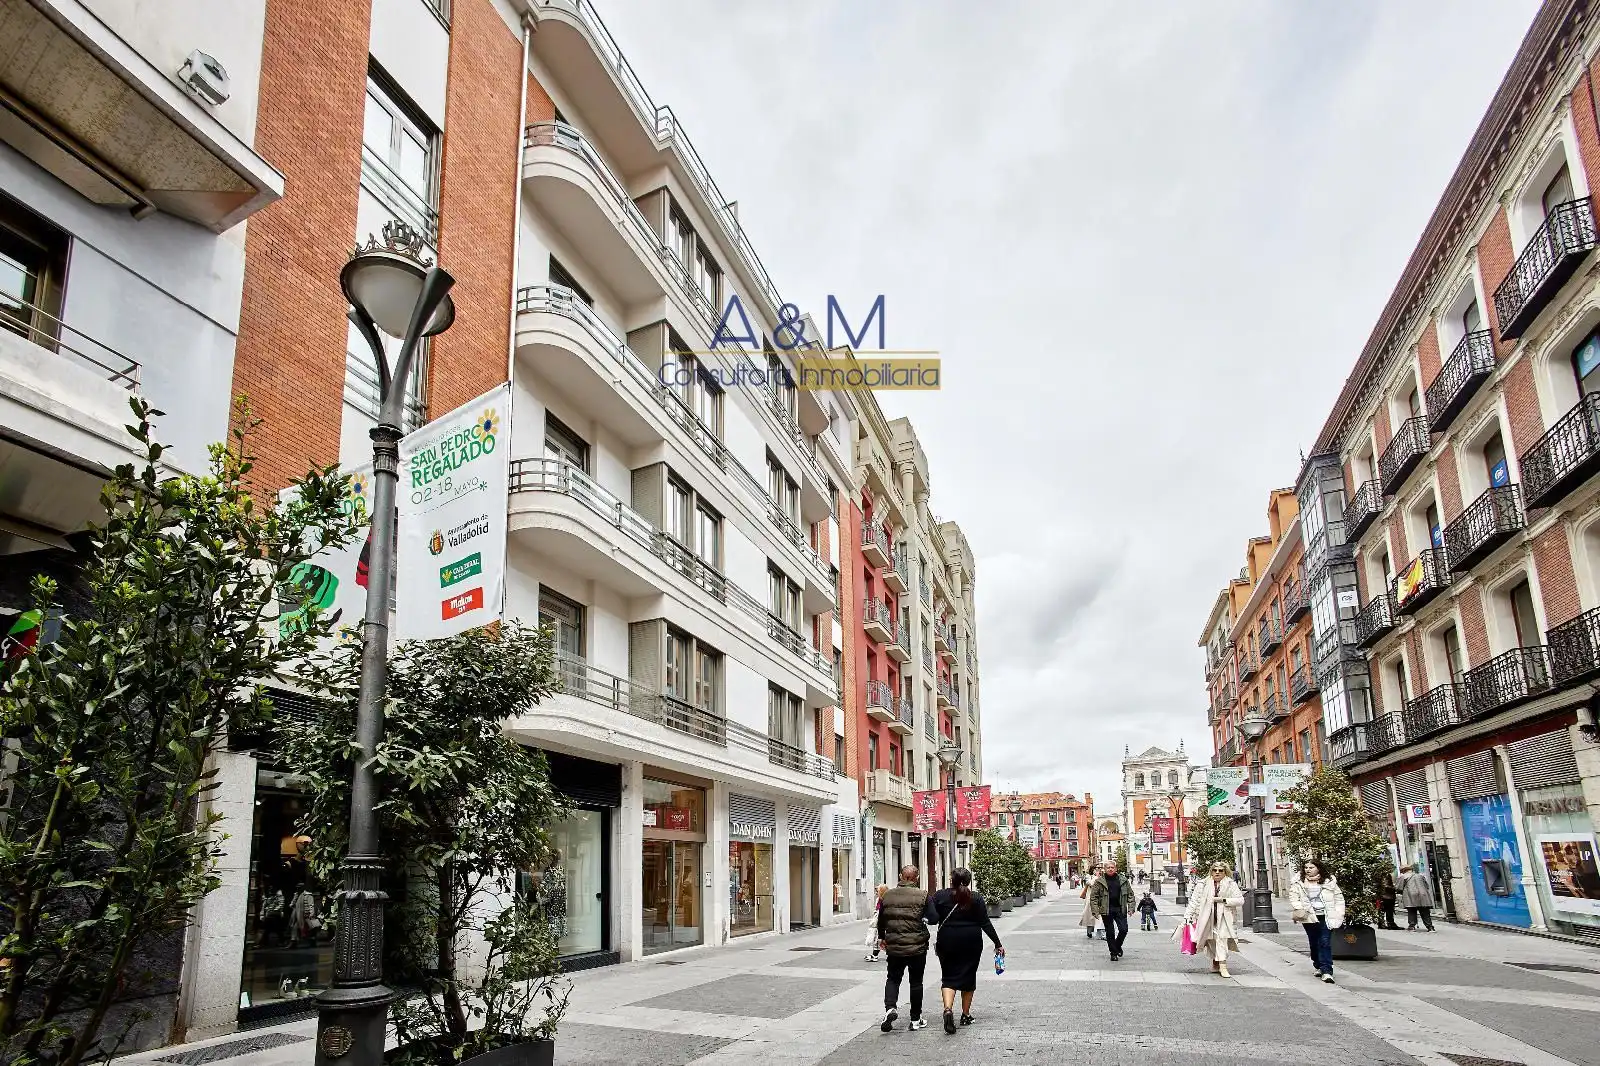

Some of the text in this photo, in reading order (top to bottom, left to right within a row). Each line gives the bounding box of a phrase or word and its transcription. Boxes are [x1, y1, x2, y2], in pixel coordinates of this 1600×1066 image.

[410, 445, 437, 470] SAN
[440, 424, 482, 456] PEDRO
[411, 434, 496, 489] REGALADO
[454, 476, 479, 496] MAYO
[448, 522, 489, 548] Valladolid
[732, 822, 773, 840] DAN JOHN
[788, 829, 818, 843] DAN JOHN
